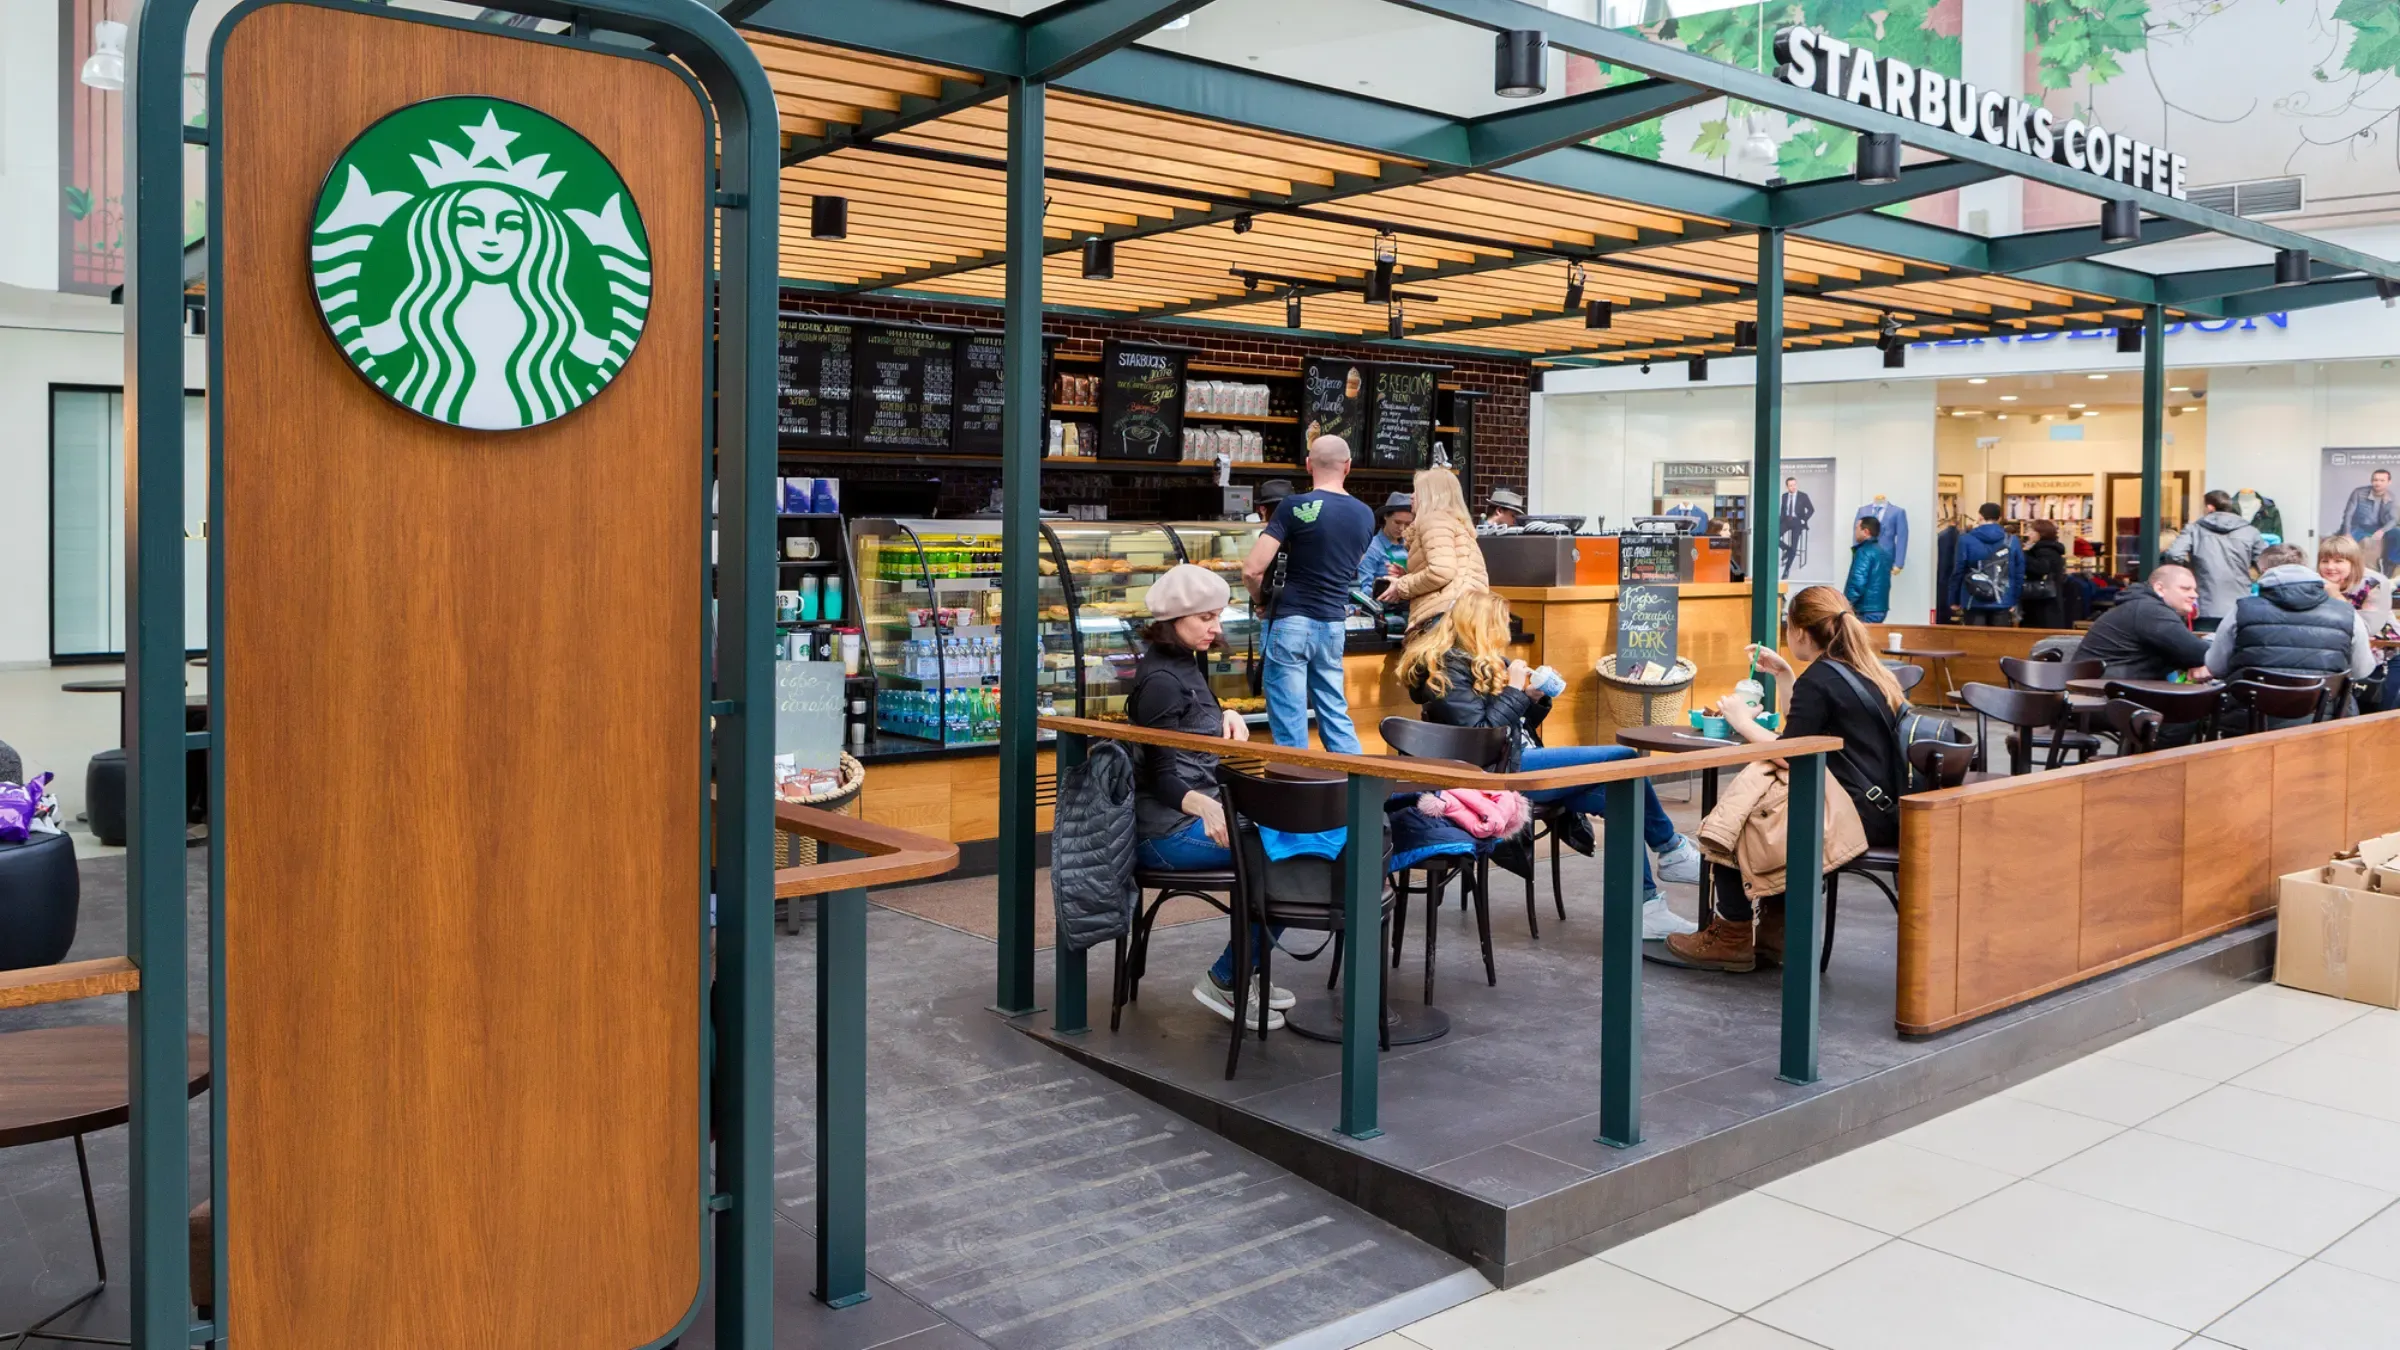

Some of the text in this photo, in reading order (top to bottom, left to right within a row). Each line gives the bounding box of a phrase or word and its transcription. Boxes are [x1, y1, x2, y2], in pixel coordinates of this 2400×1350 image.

[1776, 25, 2188, 201] STARBUCKS COFFEE
[1118, 352, 1168, 369] STARBUCKS
[1376, 373, 1387, 392] 3
[1668, 464, 1746, 476] HENDERSON
[2022, 481, 2083, 489] HENDERSON
[1619, 619, 1653, 632] Blonde
[1628, 631, 1669, 656] DARK
